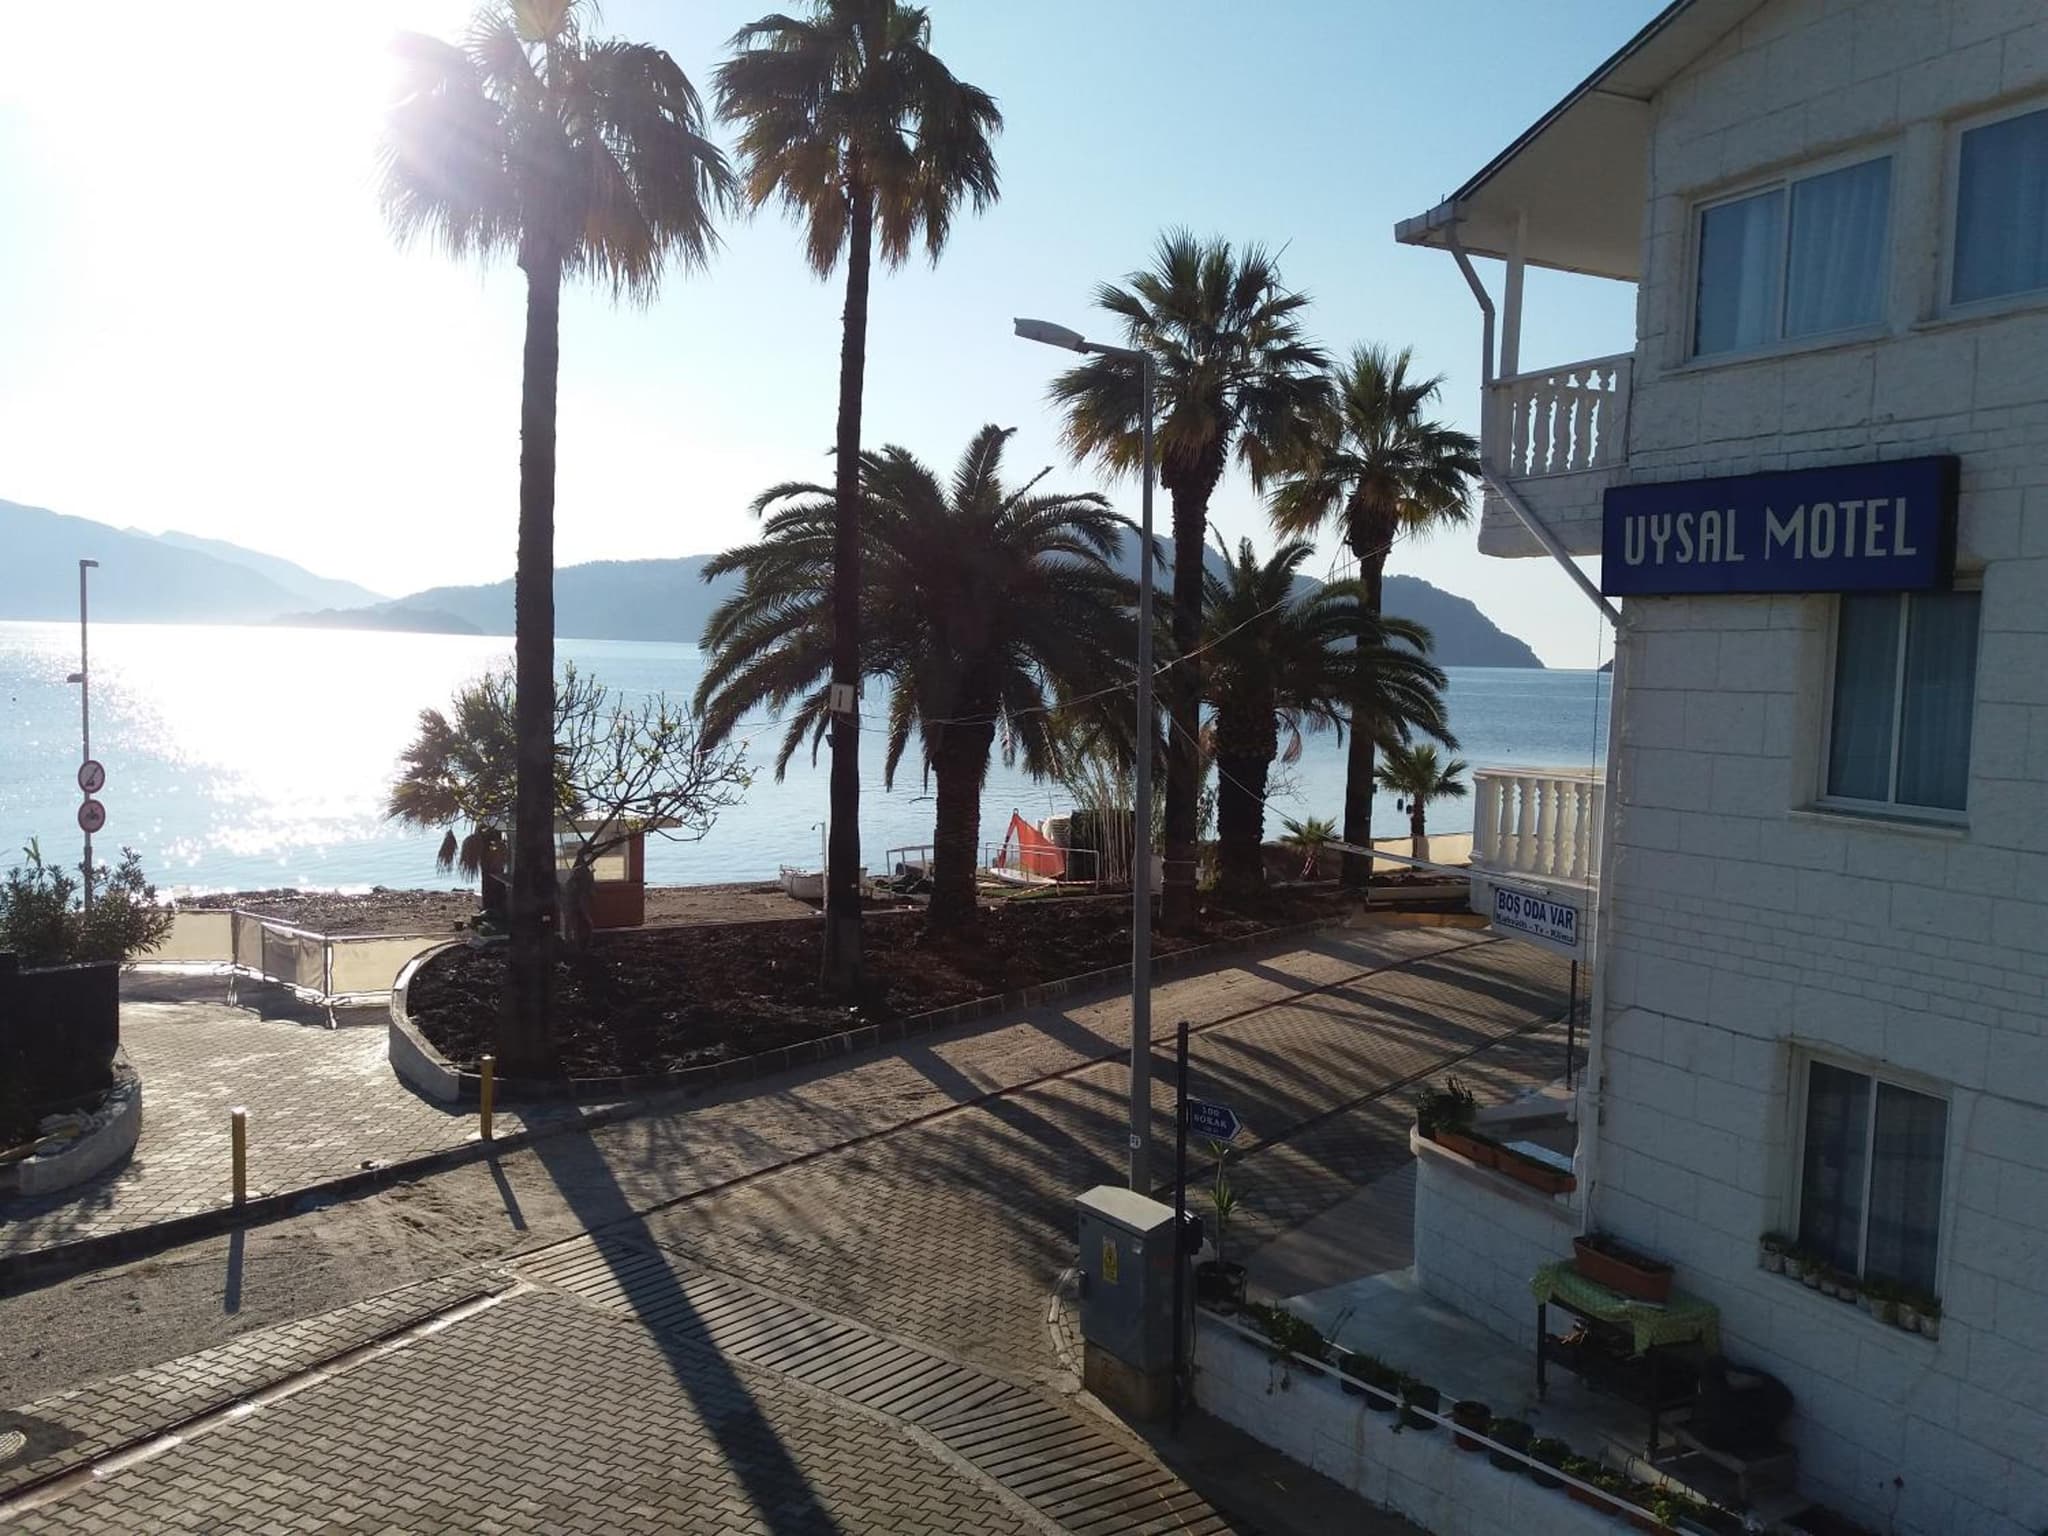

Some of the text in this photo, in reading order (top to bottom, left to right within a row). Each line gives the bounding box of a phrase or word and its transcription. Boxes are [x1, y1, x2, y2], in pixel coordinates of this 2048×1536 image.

[1623, 497, 1917, 566] UYSAL MOTEL
[1523, 898, 1547, 922] ODA
[1550, 905, 1574, 930] VAR
